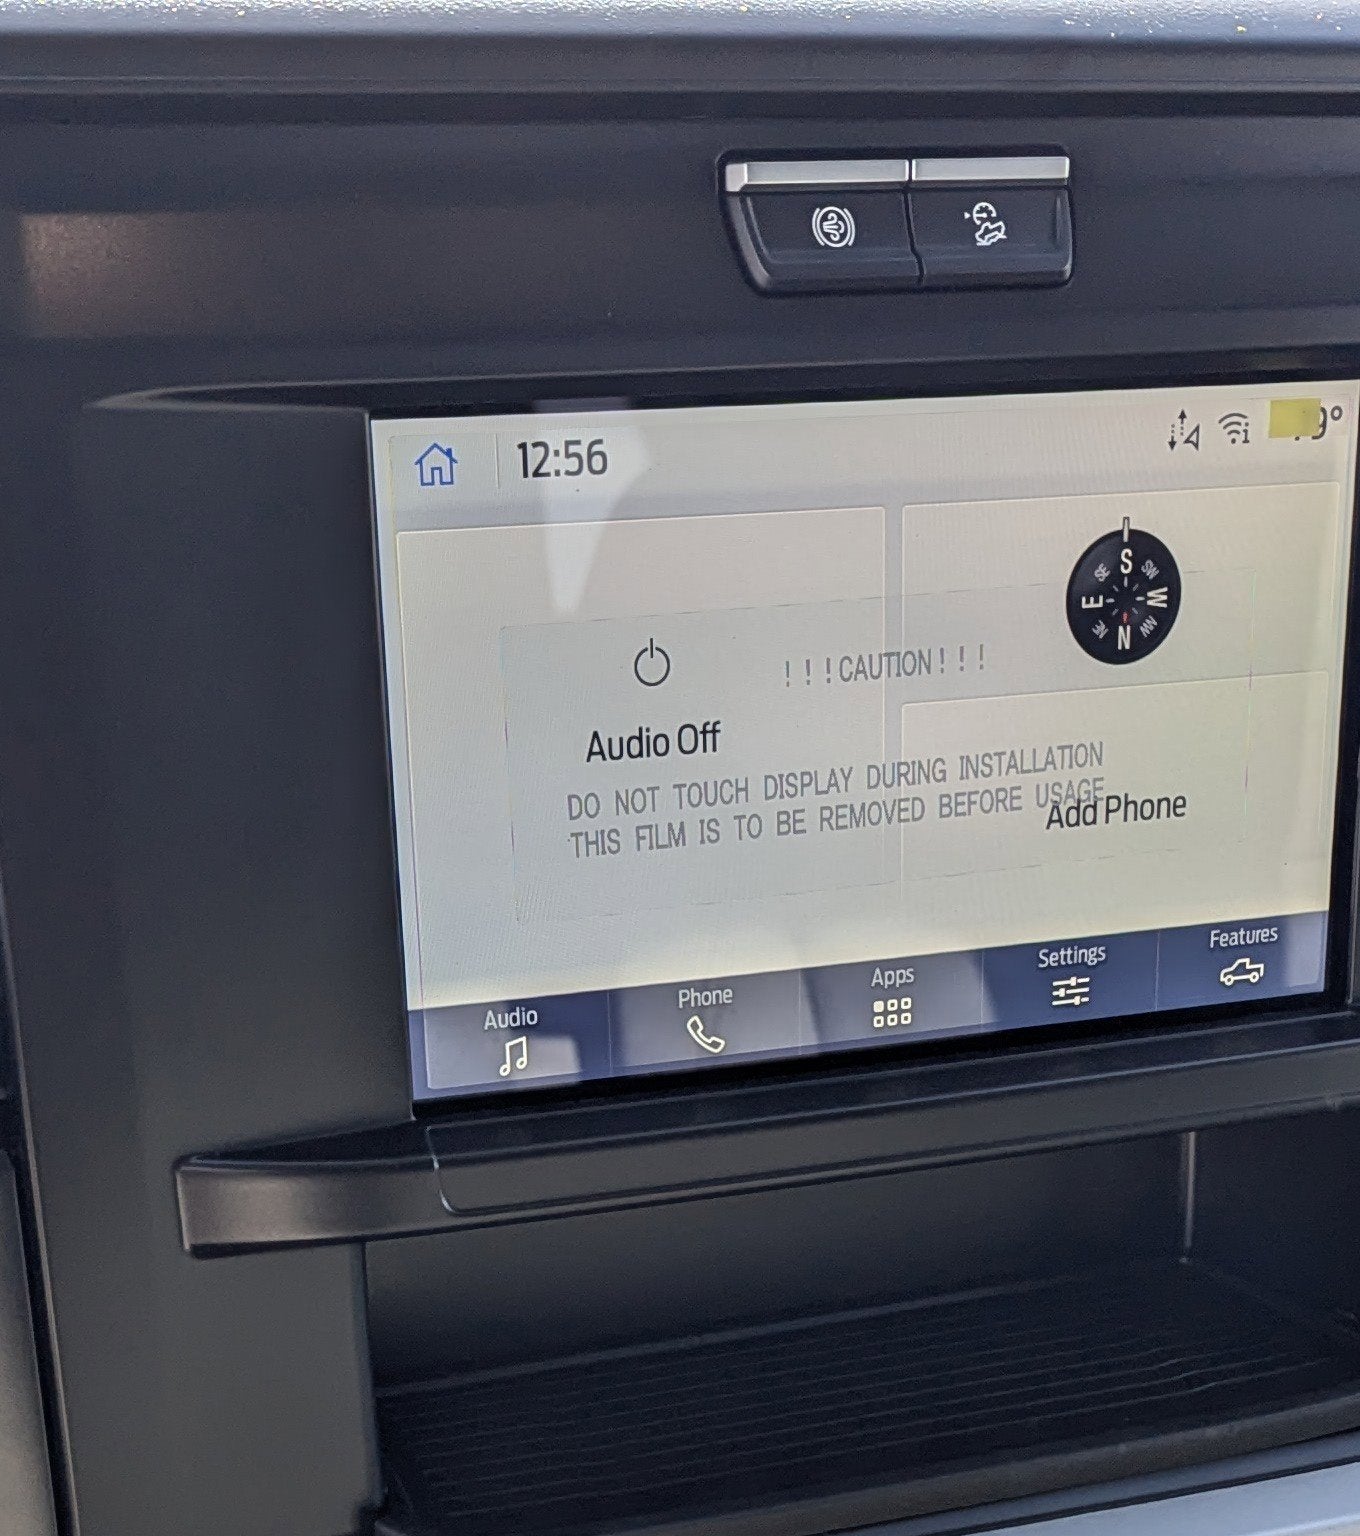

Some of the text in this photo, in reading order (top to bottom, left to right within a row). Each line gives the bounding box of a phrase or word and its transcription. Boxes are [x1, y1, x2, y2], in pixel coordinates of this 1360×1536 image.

[517, 438, 608, 478] 12:56
[1093, 562, 1111, 582] SE
[1120, 548, 1133, 574] S
[1140, 559, 1160, 580] SW
[1081, 595, 1104, 609] E
[1146, 586, 1168, 608] W
[1117, 624, 1131, 650] N
[586, 719, 721, 763] Audio Off
[567, 741, 1104, 821] DO NOT TOUCH DISPLAY DURING INSTALLATION
[570, 776, 1104, 859] THIS FILM IS TO BE REMOVED BEFORE USAGE
[1045, 793, 1188, 830] Add Phone
[1208, 926, 1279, 949] Features
[1037, 944, 1107, 969] Settings
[870, 964, 916, 989] Apps
[677, 985, 734, 1010] Phone
[483, 1005, 539, 1031] Audio
